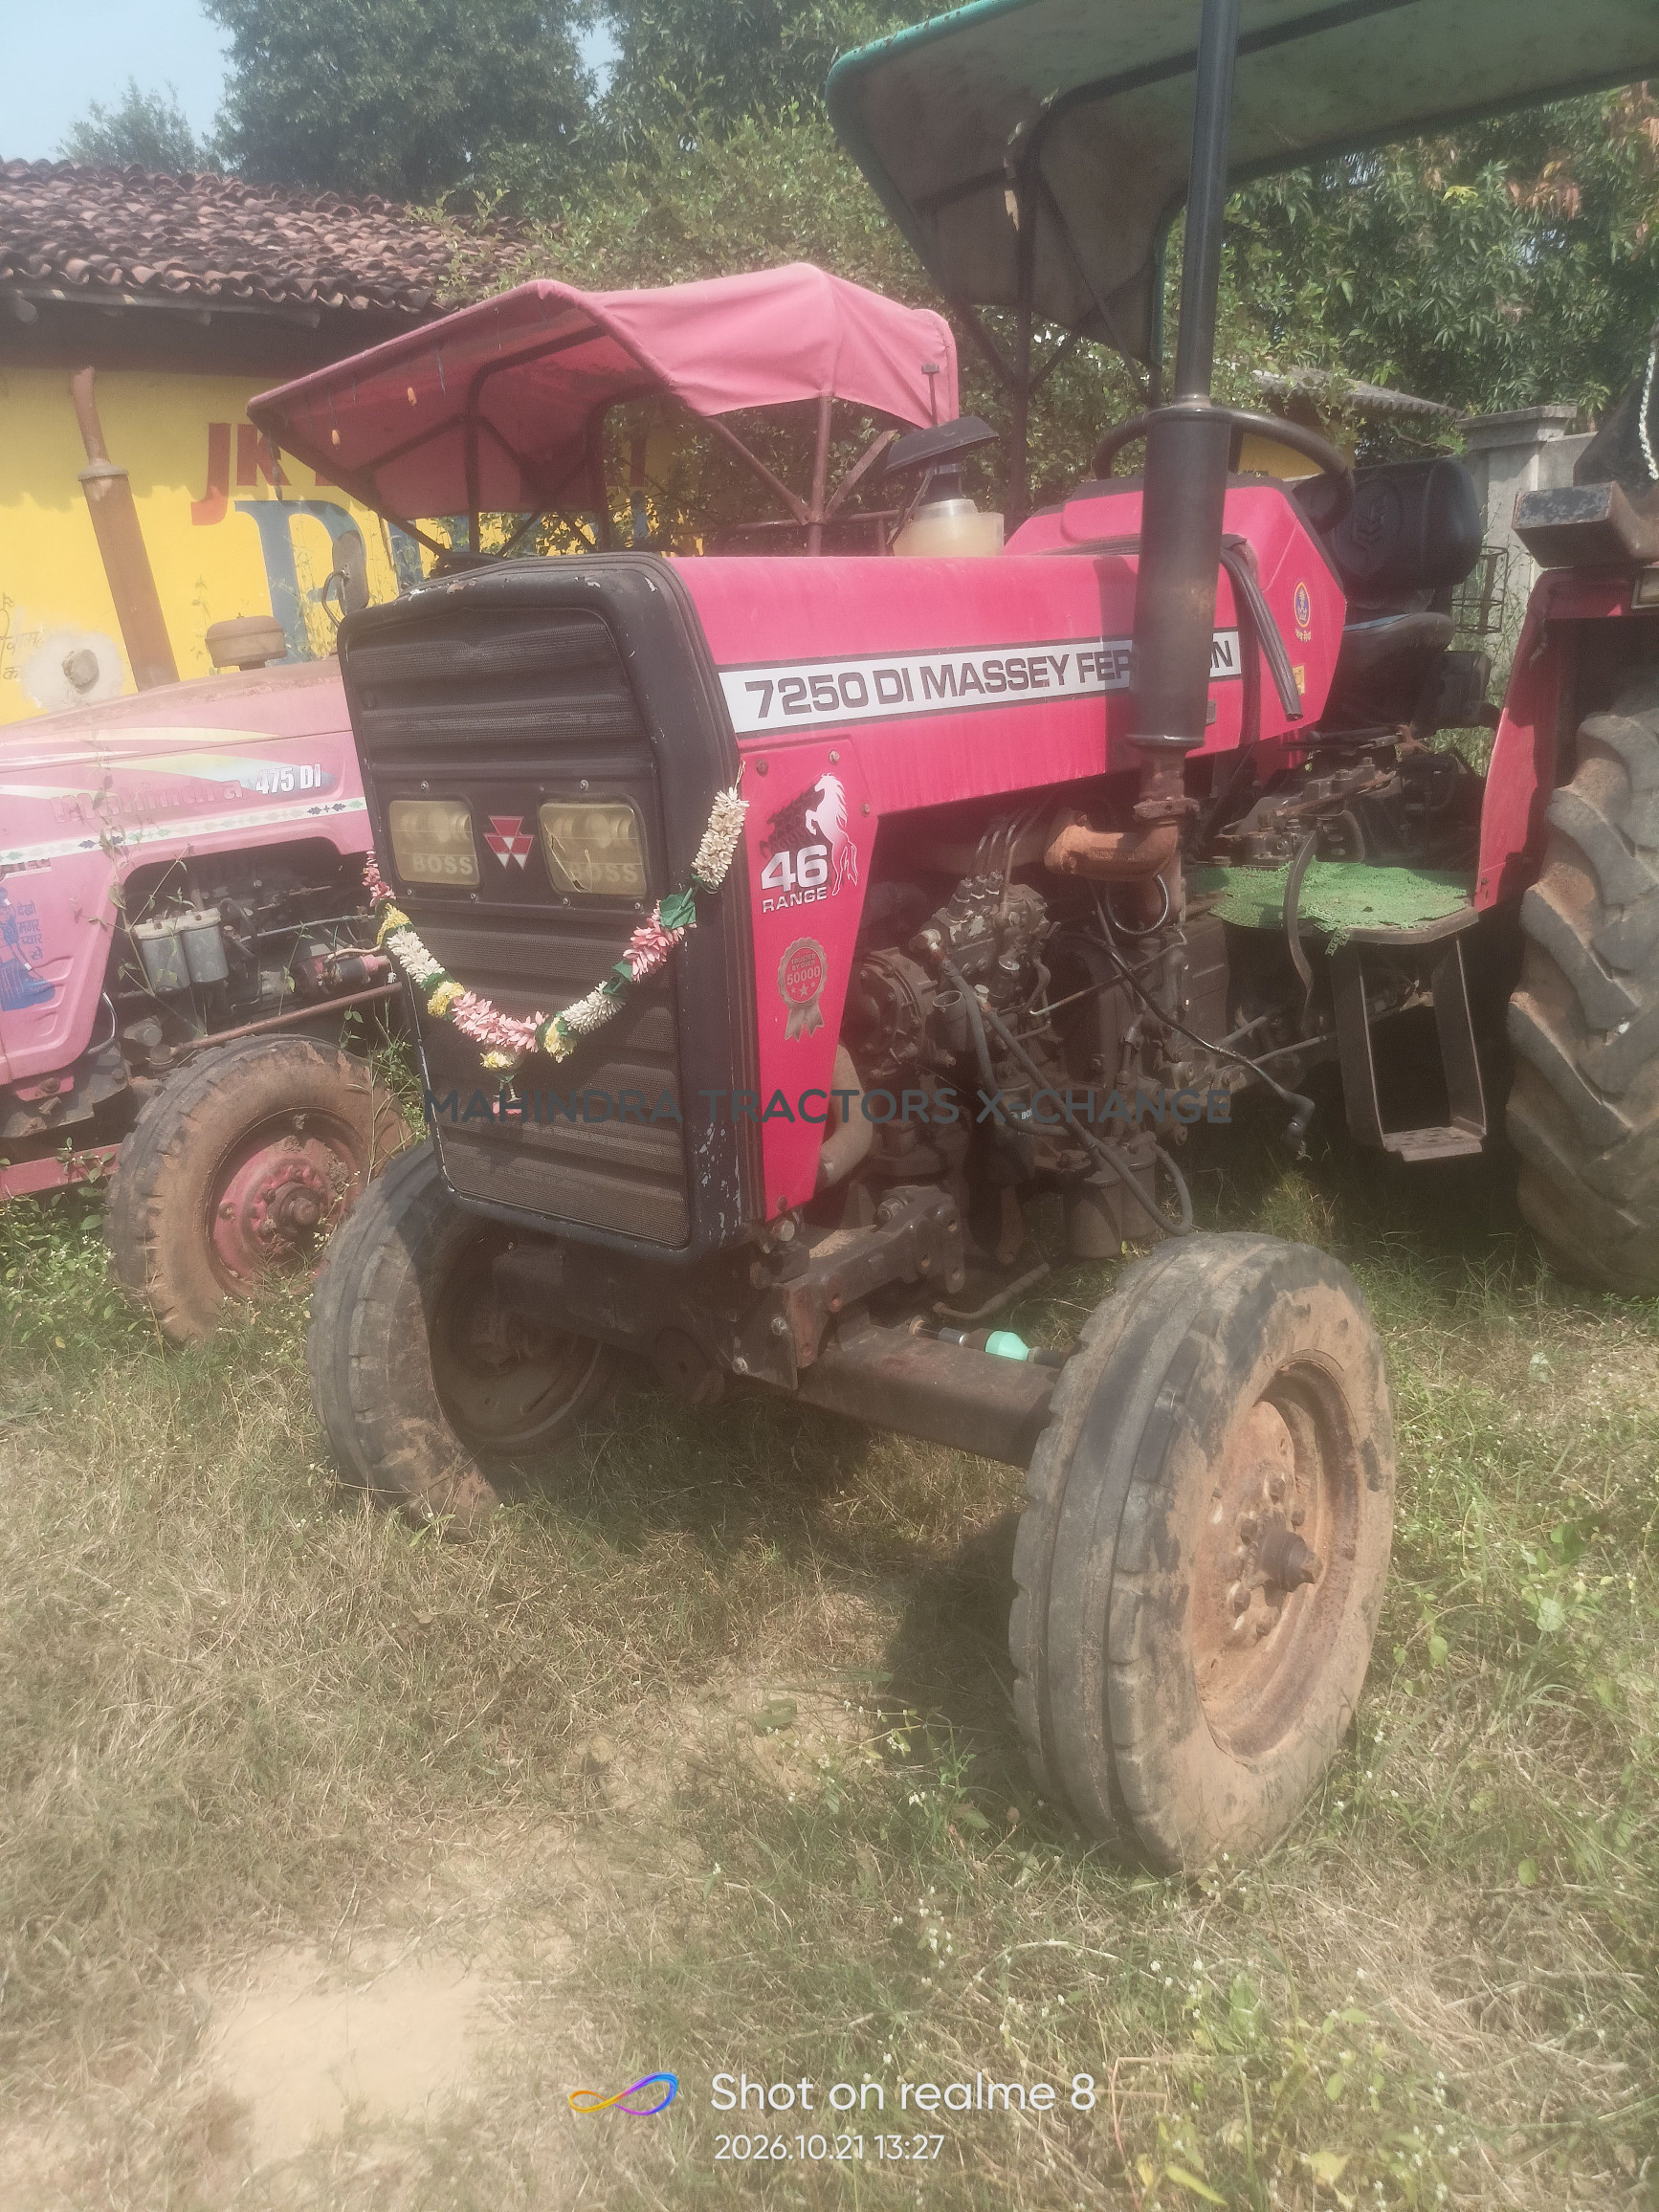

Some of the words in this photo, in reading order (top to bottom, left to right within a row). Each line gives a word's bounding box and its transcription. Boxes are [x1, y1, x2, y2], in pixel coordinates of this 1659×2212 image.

[190, 422, 291, 525] JK
[744, 672, 869, 718] 7250
[873, 667, 914, 704] DI
[918, 653, 1070, 700] MASSEY
[255, 766, 295, 795] 475
[299, 763, 321, 789] DI
[412, 853, 474, 874] BOSS
[761, 844, 828, 892] 46
[763, 886, 828, 913] RANGE
[791, 954, 816, 964] TRUSTED
[786, 965, 821, 985] 50000
